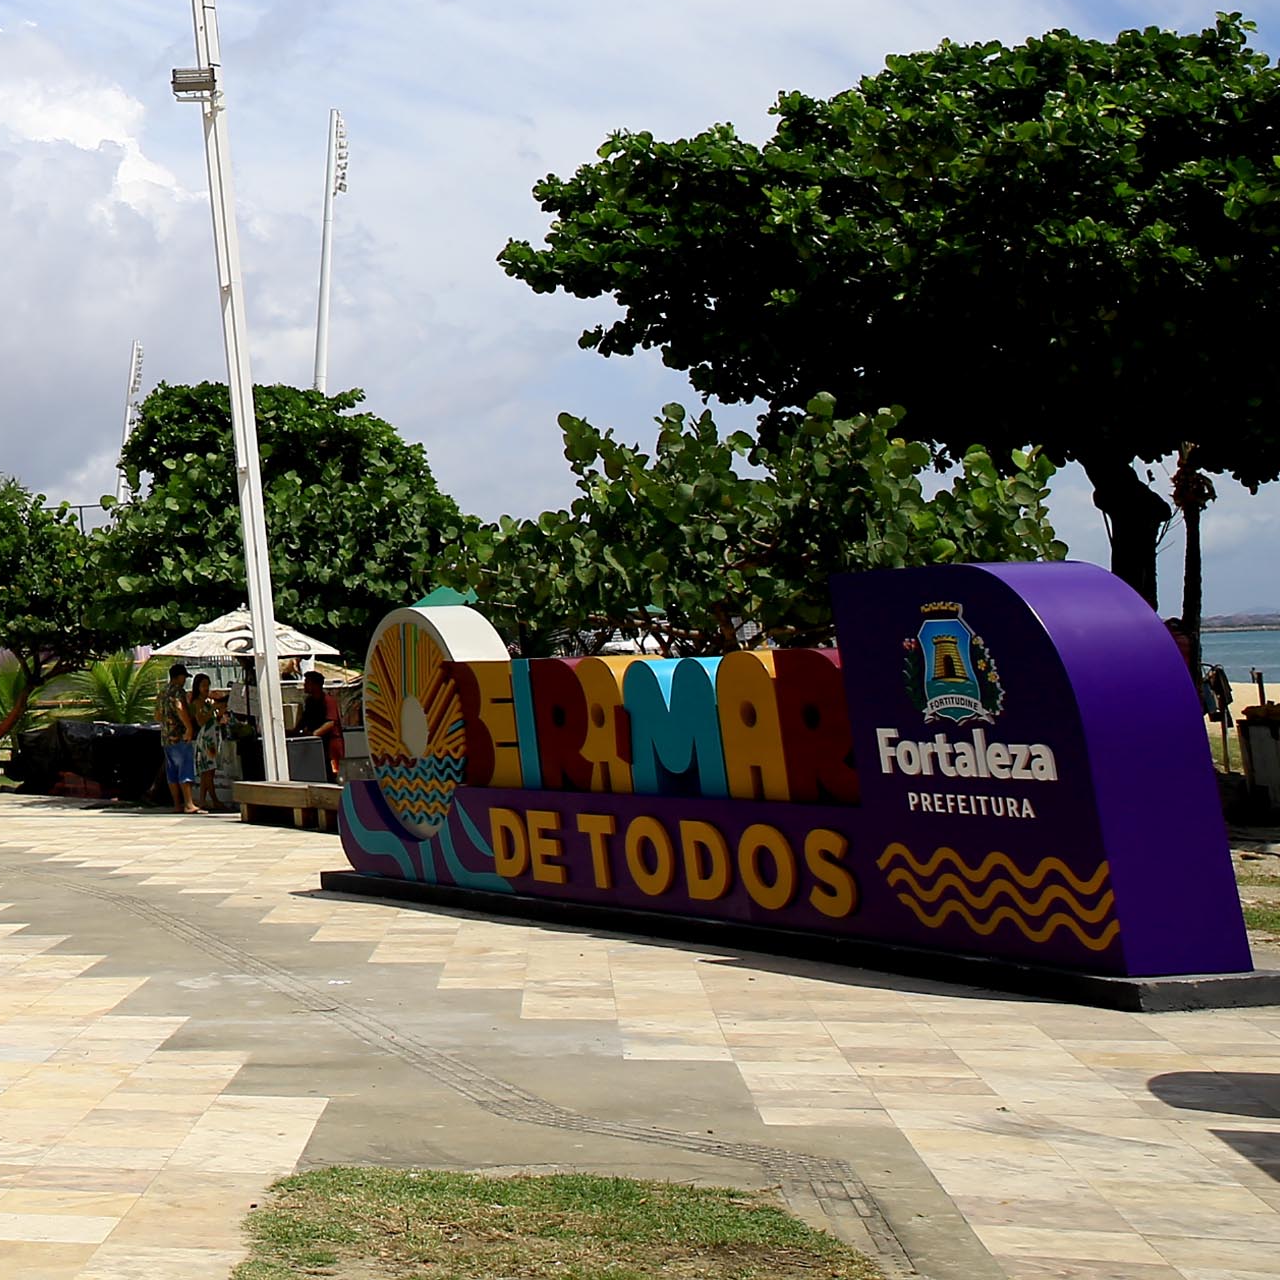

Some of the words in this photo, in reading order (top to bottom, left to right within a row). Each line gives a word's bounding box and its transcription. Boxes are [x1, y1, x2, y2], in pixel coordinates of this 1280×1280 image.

[929, 696, 980, 711] FORTITUDINE
[876, 728, 1058, 781] Fortaleza
[908, 792, 1036, 818] PREFEITURA
[488, 807, 567, 884] DE
[576, 813, 857, 918] TODOS
